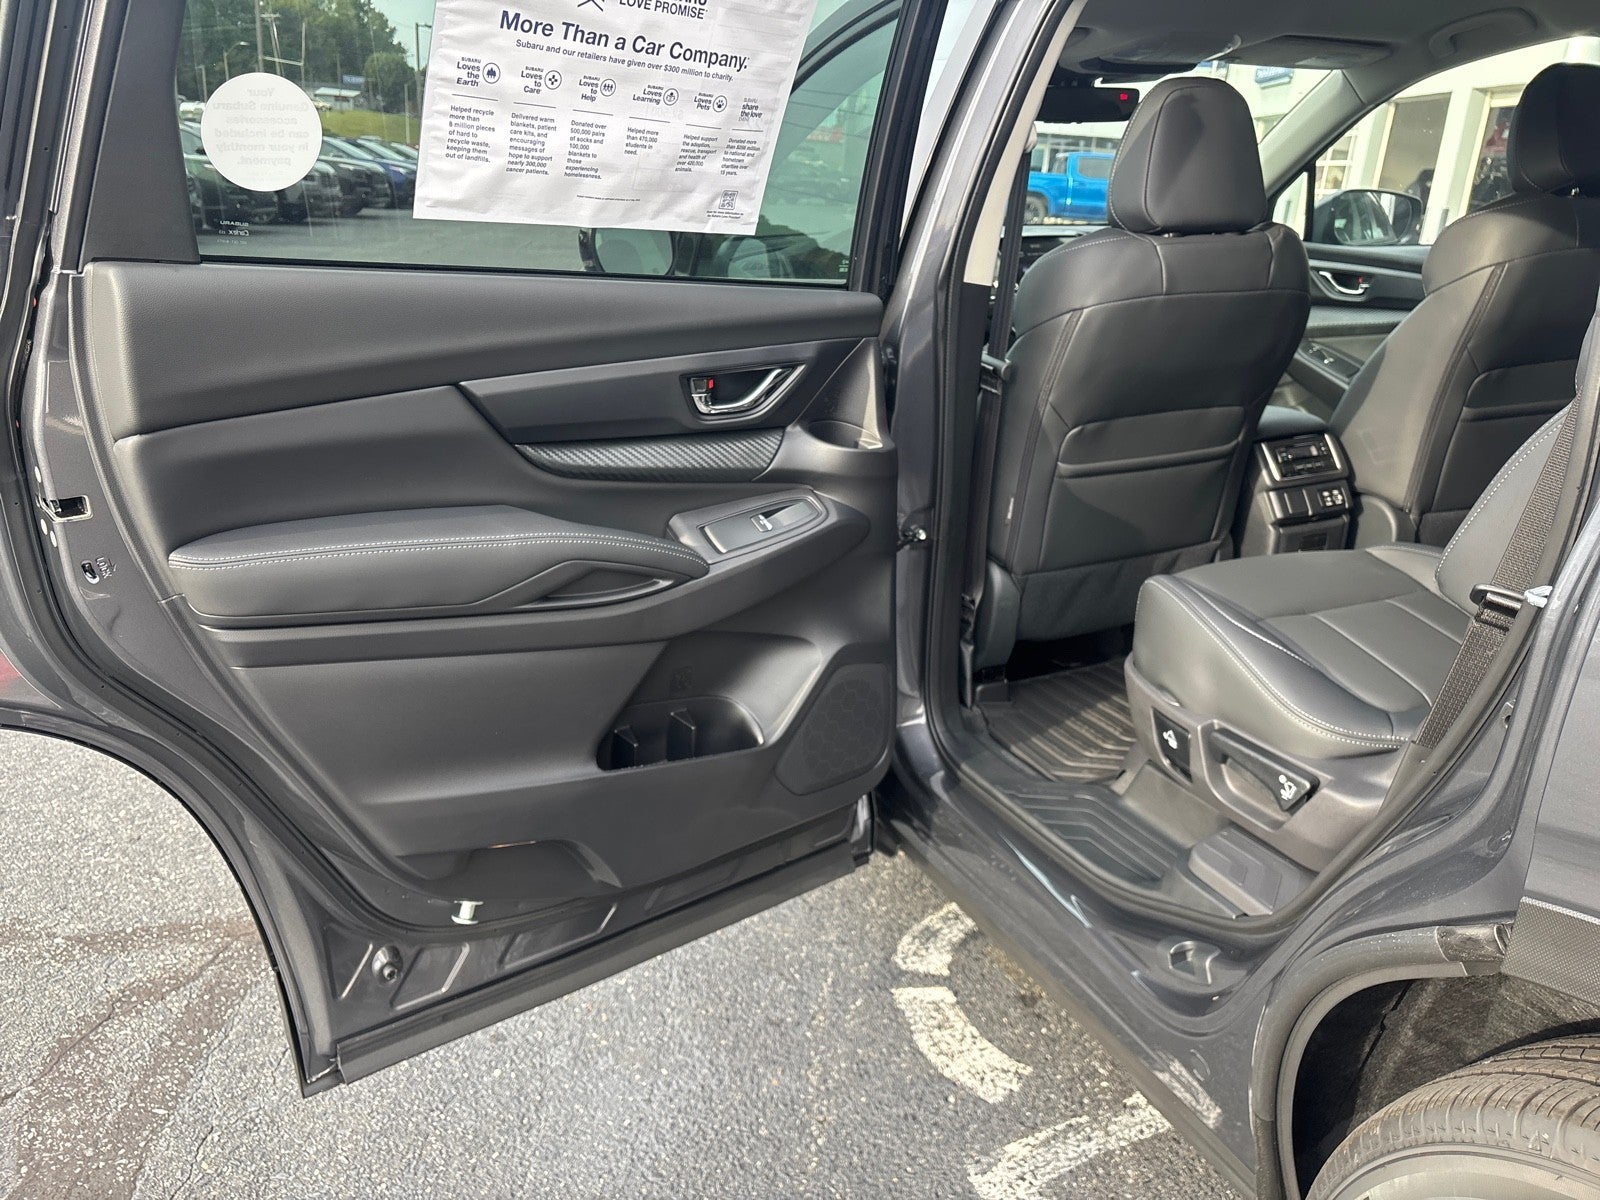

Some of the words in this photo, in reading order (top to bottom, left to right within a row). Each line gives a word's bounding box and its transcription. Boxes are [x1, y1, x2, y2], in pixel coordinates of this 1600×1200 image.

[654, 0, 705, 19] PROMISE
[500, 10, 554, 37] More
[562, 22, 609, 47] Than
[614, 36, 626, 50] a
[632, 35, 665, 56] Car
[670, 42, 748, 72] Company.
[516, 39, 544, 51] Subaru
[577, 51, 607, 62] retailers
[608, 55, 626, 65] have
[626, 58, 646, 68] given
[647, 62, 662, 70] over
[664, 64, 680, 74] $300
[681, 67, 703, 77] million
[712, 72, 734, 82] charity.
[457, 61, 480, 71] Loves
[467, 71, 480, 80] the
[521, 70, 543, 80] Loves
[456, 77, 479, 87] Earth
[579, 79, 599, 88] Loves
[523, 86, 541, 94] Care
[643, 88, 662, 97] Loves
[581, 93, 596, 102] Help
[633, 94, 661, 105] Learning
[694, 96, 712, 104] Loves
[450, 105, 471, 113] Helped
[473, 107, 495, 116] recycle
[696, 102, 711, 110] Pets
[511, 112, 538, 122] Delivered
[749, 110, 762, 118] love
[476, 124, 495, 132] pieces
[510, 120, 536, 129] blankets,
[571, 120, 593, 128] Donated
[510, 137, 545, 147] encouraging
[446, 144, 471, 153] keeping
[509, 145, 538, 153] messages
[464, 154, 491, 163] landfills.
[96, 557, 112, 579] LOCK
